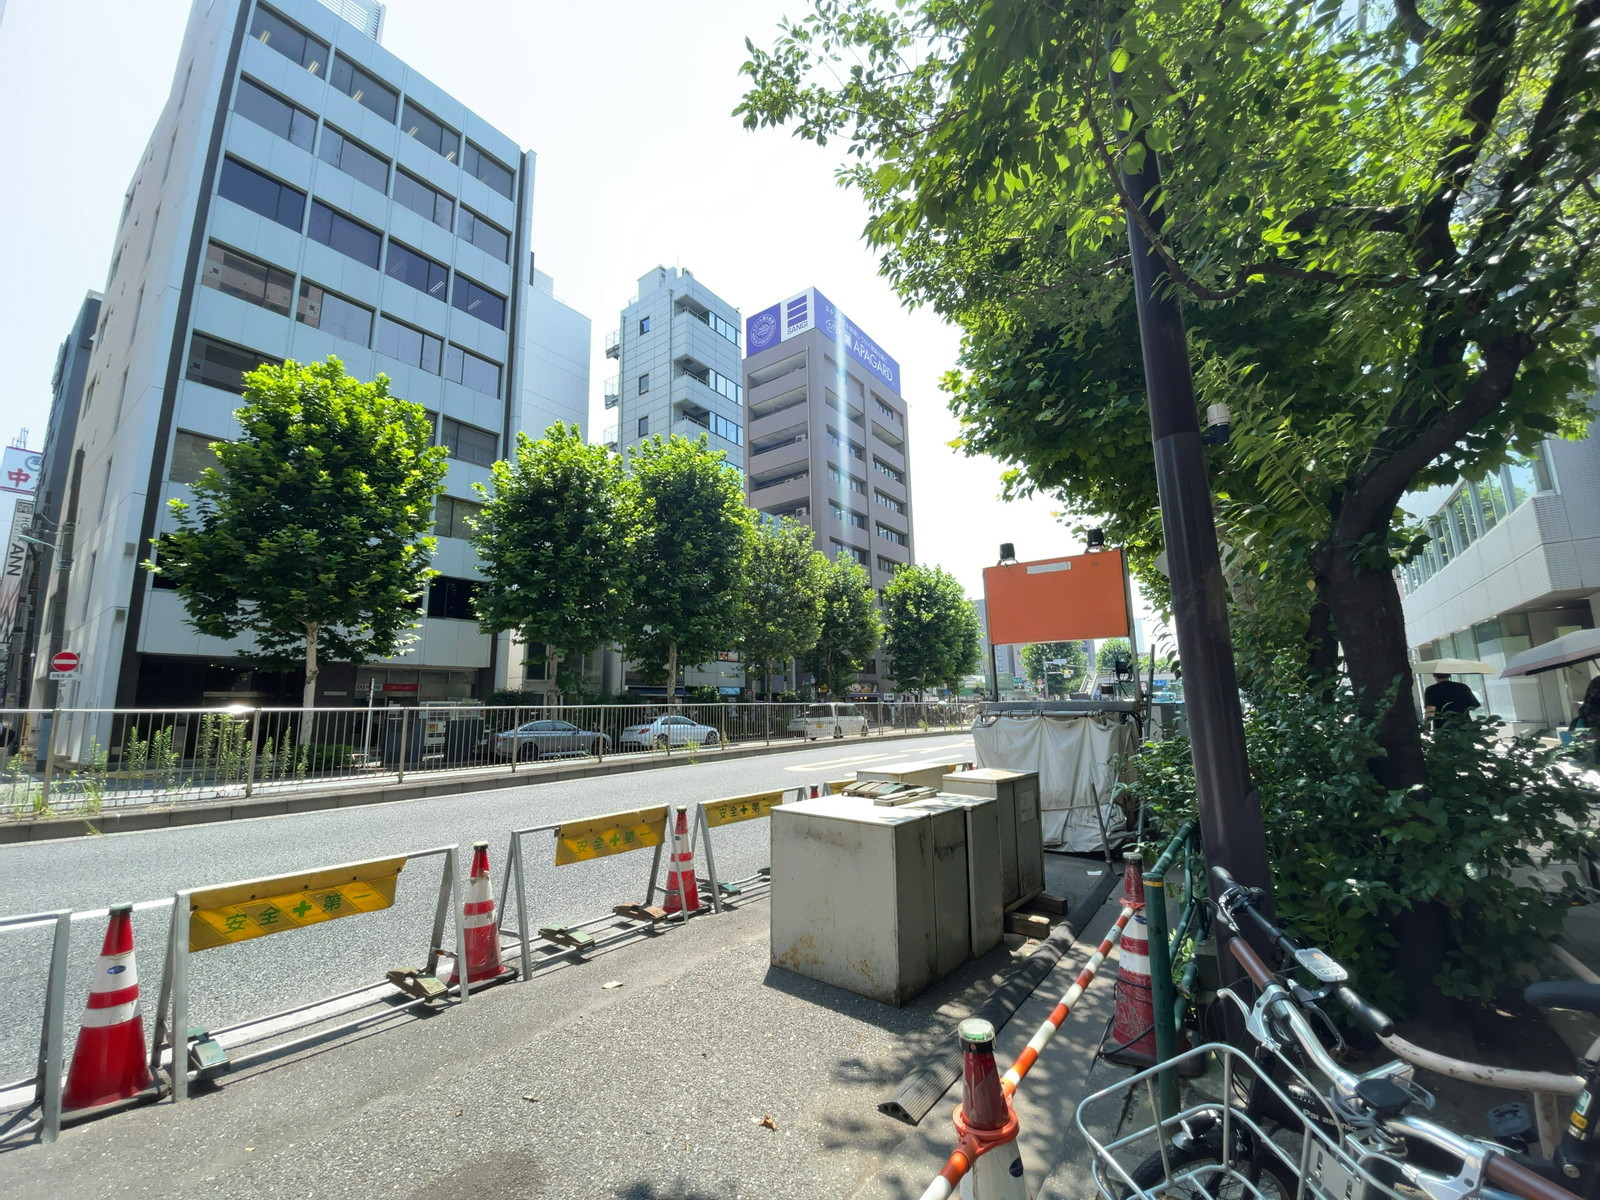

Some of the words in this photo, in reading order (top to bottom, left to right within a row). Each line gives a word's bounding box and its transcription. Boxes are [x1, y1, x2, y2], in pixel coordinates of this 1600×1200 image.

[787, 321, 808, 335] SANGI
[853, 340, 893, 382] APAGARD
[8, 468, 31, 487] 中
[8, 543, 26, 576] ANN
[224, 906, 281, 935] 安全
[322, 893, 371, 912] 第一
[1303, 1108, 1357, 1132] Paasnic
